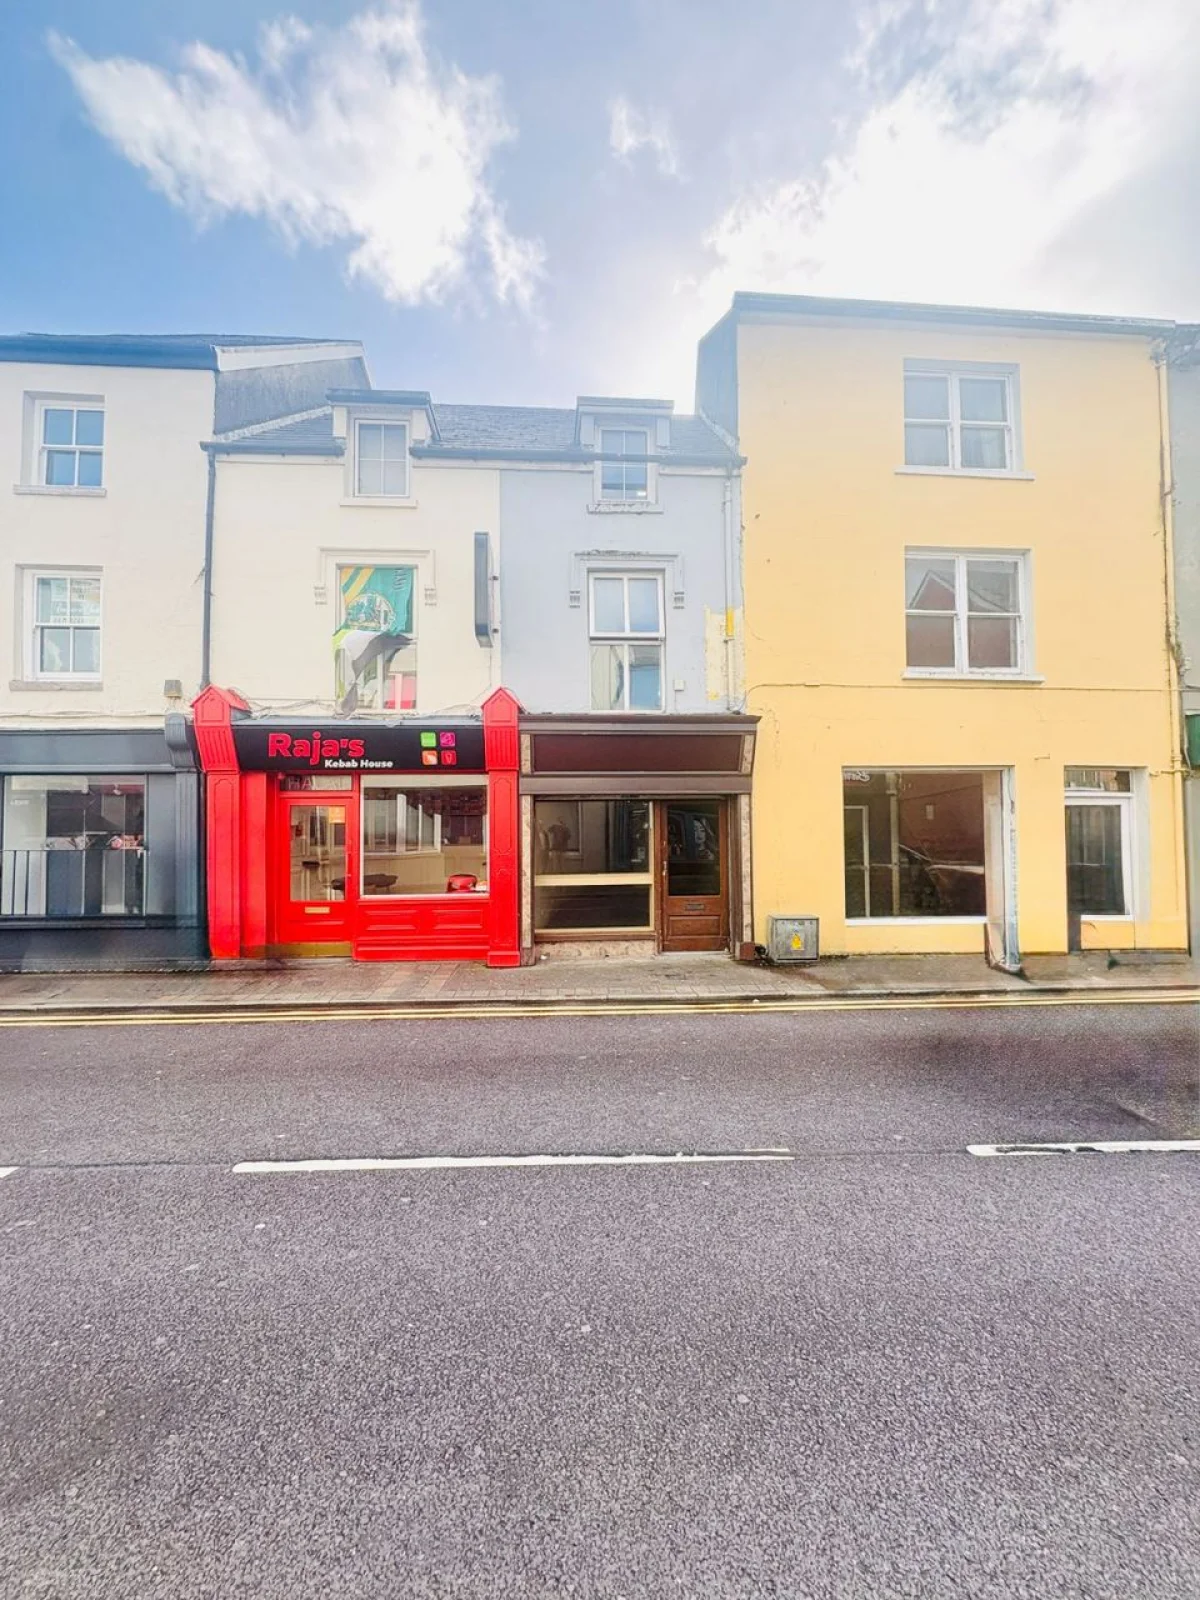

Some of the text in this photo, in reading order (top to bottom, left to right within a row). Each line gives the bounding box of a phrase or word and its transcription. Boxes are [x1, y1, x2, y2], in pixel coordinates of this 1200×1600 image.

[268, 731, 365, 765] Raja's
[324, 759, 394, 769] Kebab House
